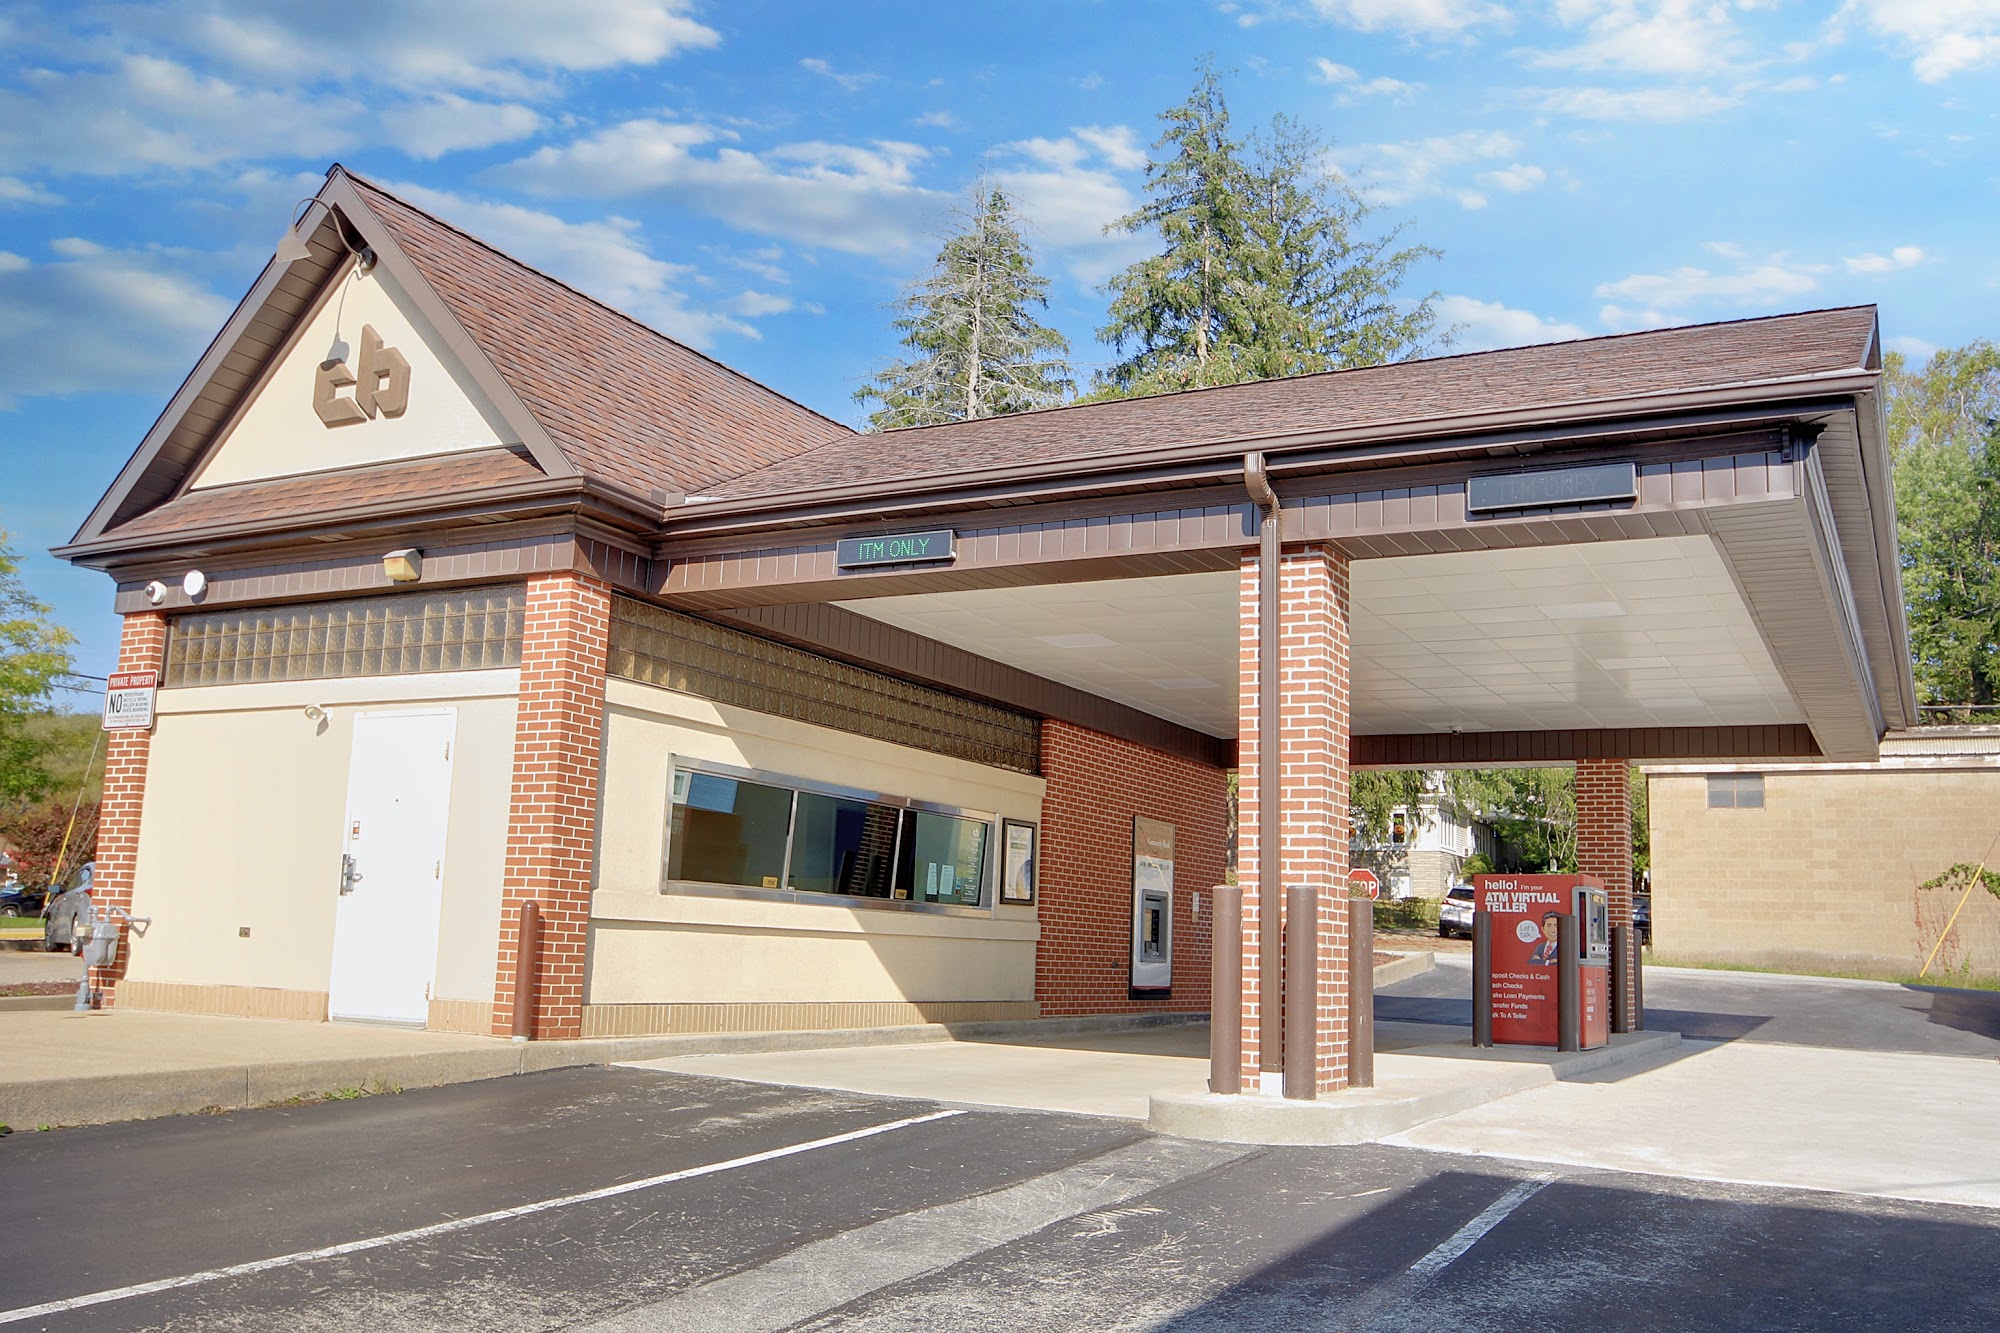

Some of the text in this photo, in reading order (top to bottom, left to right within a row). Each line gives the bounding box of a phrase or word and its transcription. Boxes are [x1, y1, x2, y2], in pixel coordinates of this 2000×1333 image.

[859, 538, 930, 560] ITM ONLY
[110, 675, 154, 687] PRIVATE PROPERTY
[109, 694, 122, 714] NO
[1485, 880, 1517, 890] hello!
[1485, 892, 1560, 903] ATM VIRTUAL
[1485, 902, 1527, 912] TELLER
[1520, 924, 1535, 932] Let's
